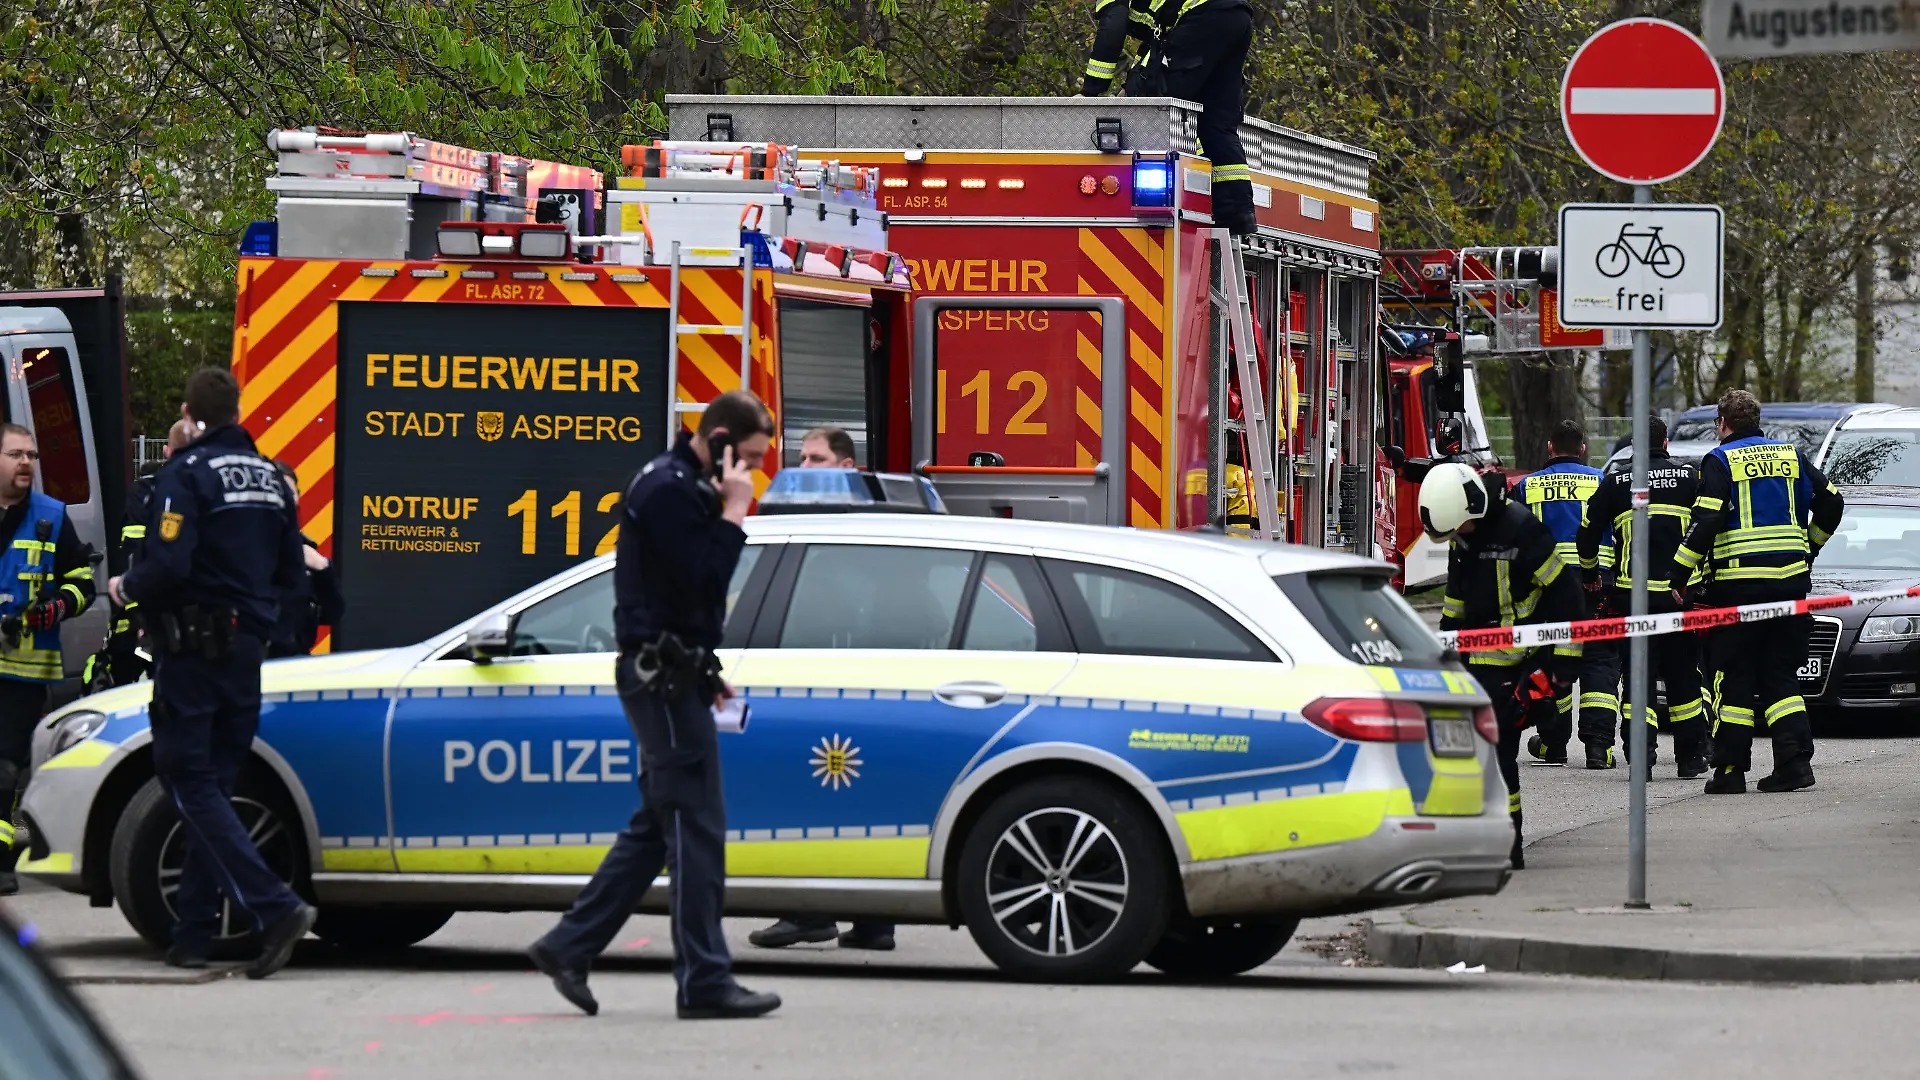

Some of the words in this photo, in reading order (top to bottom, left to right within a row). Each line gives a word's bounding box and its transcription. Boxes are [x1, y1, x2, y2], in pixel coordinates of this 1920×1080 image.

[884, 196, 901, 207] FL.
[904, 196, 931, 208] ASP.
[934, 196, 948, 208] 54
[465, 283, 488, 299] FL.
[490, 284, 524, 300] ASP.
[528, 285, 545, 301] 72
[1616, 287, 1663, 311] frei
[366, 353, 641, 393] FEUERWEHR
[365, 411, 465, 438] STADT
[511, 414, 641, 442] ASPERG
[1738, 445, 1794, 455] FEUERWEHR
[1742, 452, 1779, 463] ASPERG
[1615, 468, 1689, 485] FERWEHR
[1744, 461, 1792, 478] GW-G
[1544, 486, 1578, 501] DLK
[362, 495, 479, 520] NOTRUF
[362, 524, 446, 537] FEUERWEHR
[450, 527, 459, 538] &
[361, 539, 481, 553] RETTUNGSDIENST
[1538, 619, 1657, 642] POLIZEIABSPERRUNG
[444, 739, 642, 783] POLIZE
